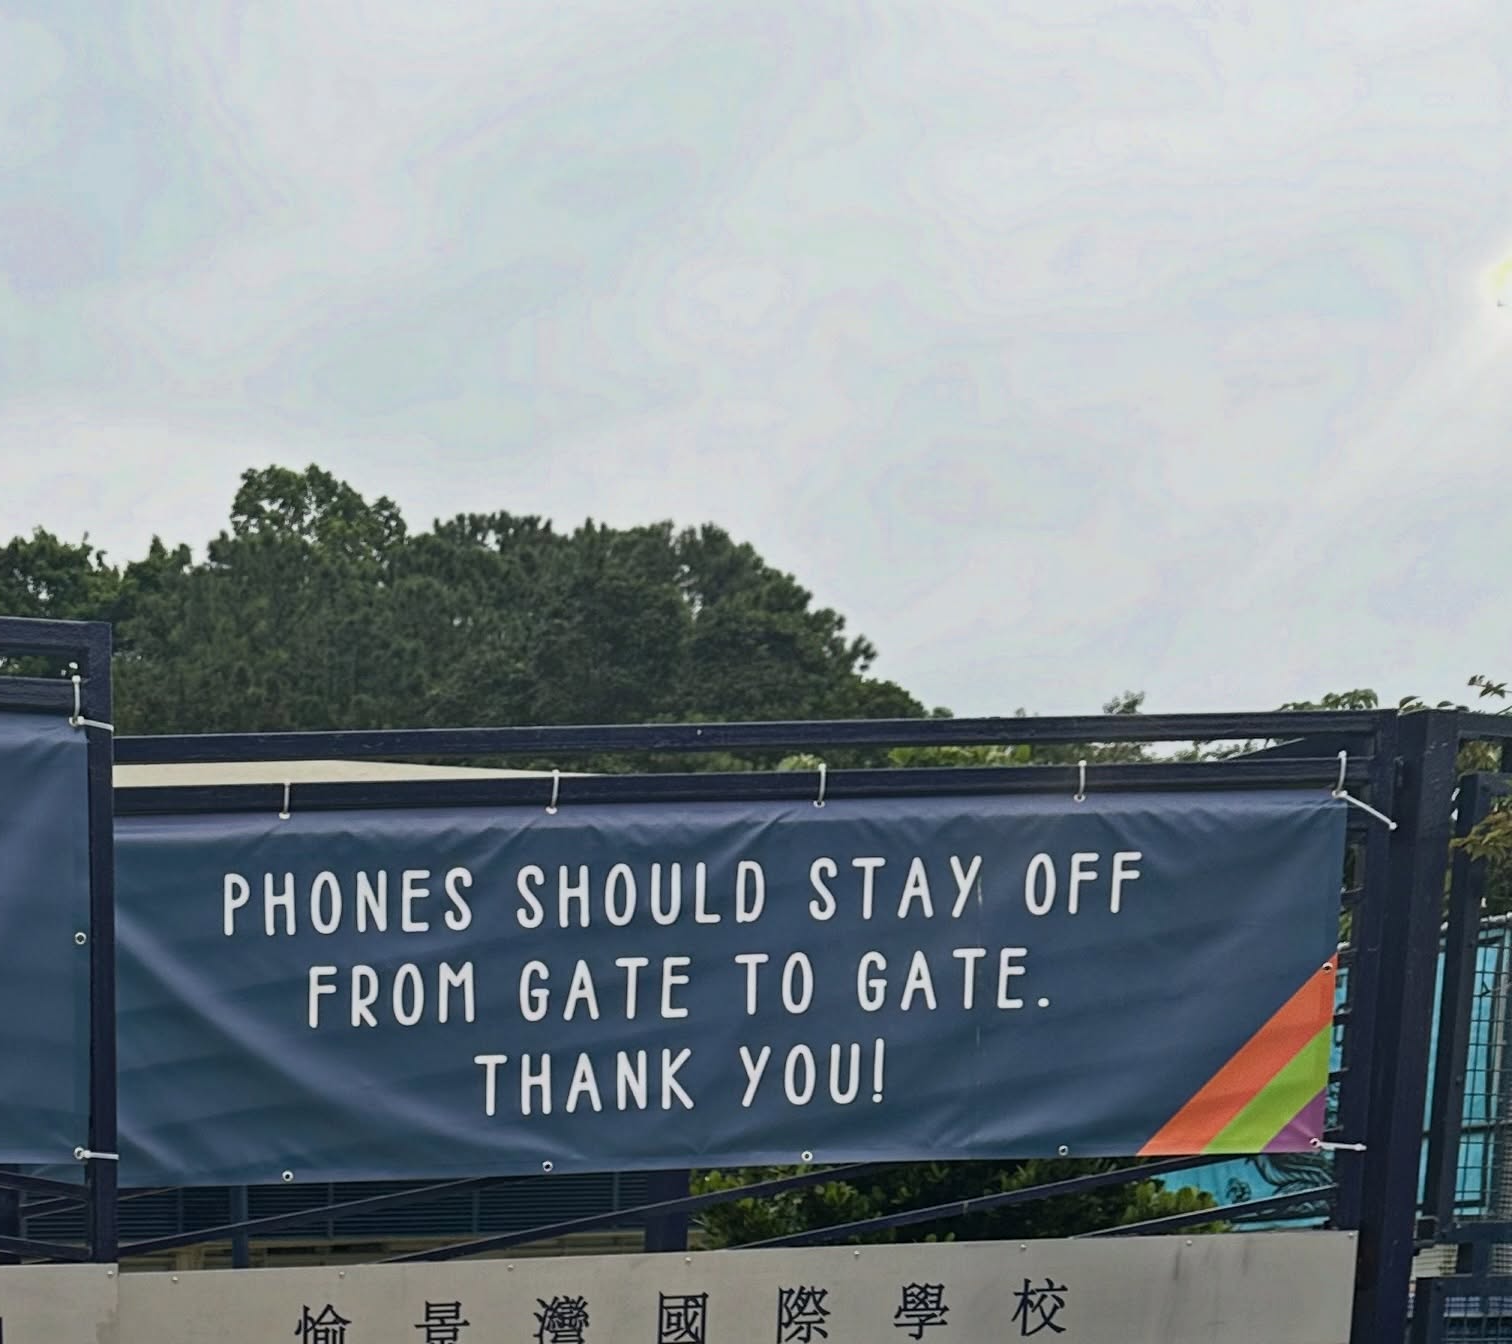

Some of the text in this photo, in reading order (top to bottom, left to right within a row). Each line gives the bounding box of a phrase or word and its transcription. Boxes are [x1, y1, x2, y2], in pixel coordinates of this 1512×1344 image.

[224, 851, 1142, 936] PHONES SHOULD STAY OFF
[308, 947, 1049, 1029] FROM GATE TO GATE.
[474, 1038, 885, 1116] THANK YOU!
